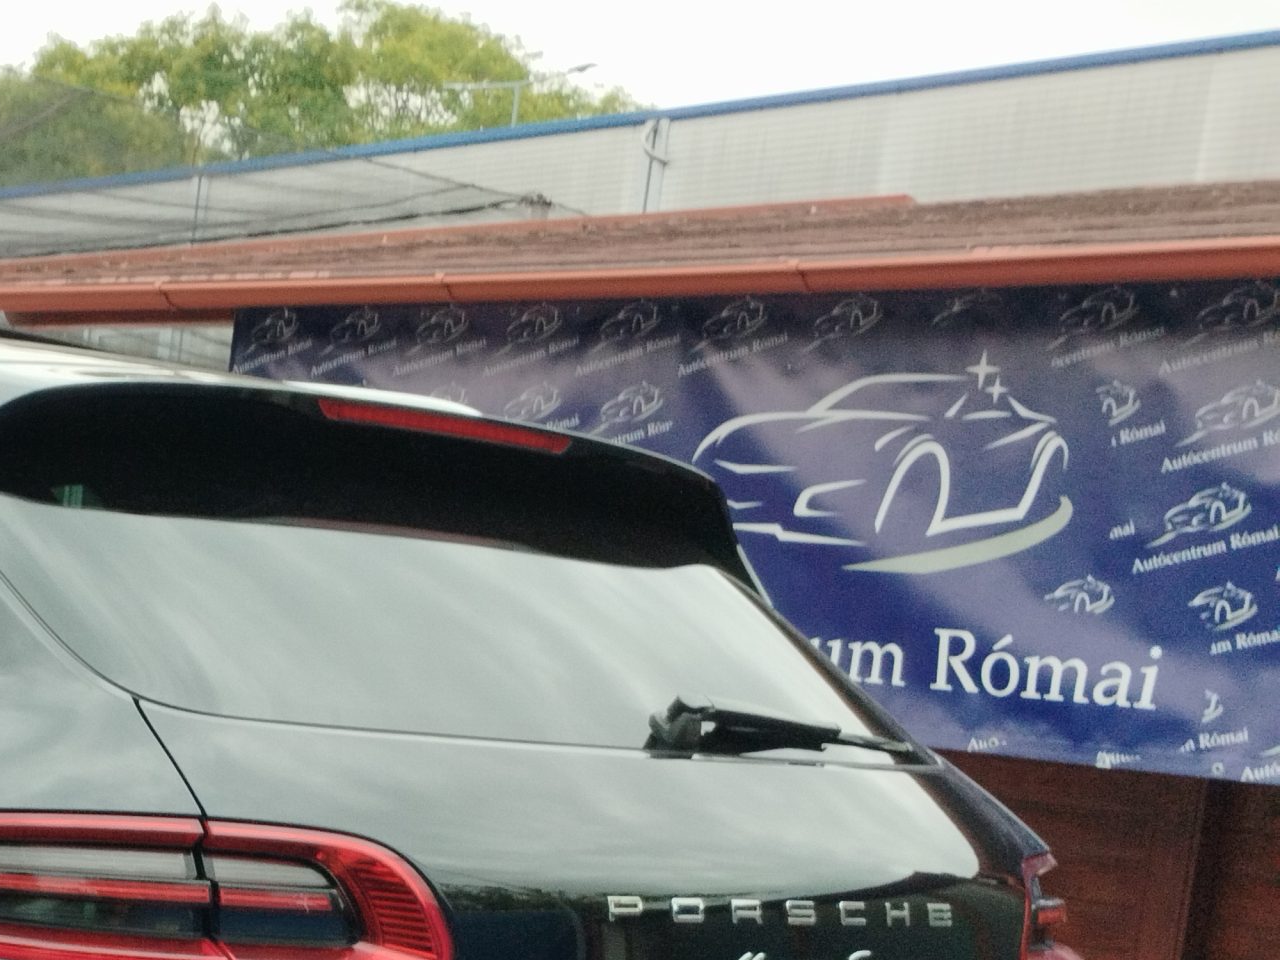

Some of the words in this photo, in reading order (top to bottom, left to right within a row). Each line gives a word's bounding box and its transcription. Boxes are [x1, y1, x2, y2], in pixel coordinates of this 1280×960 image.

[1131, 539, 1227, 574] Autócentrum
[929, 627, 1159, 710] Római
[606, 895, 954, 928] PORSCHE
